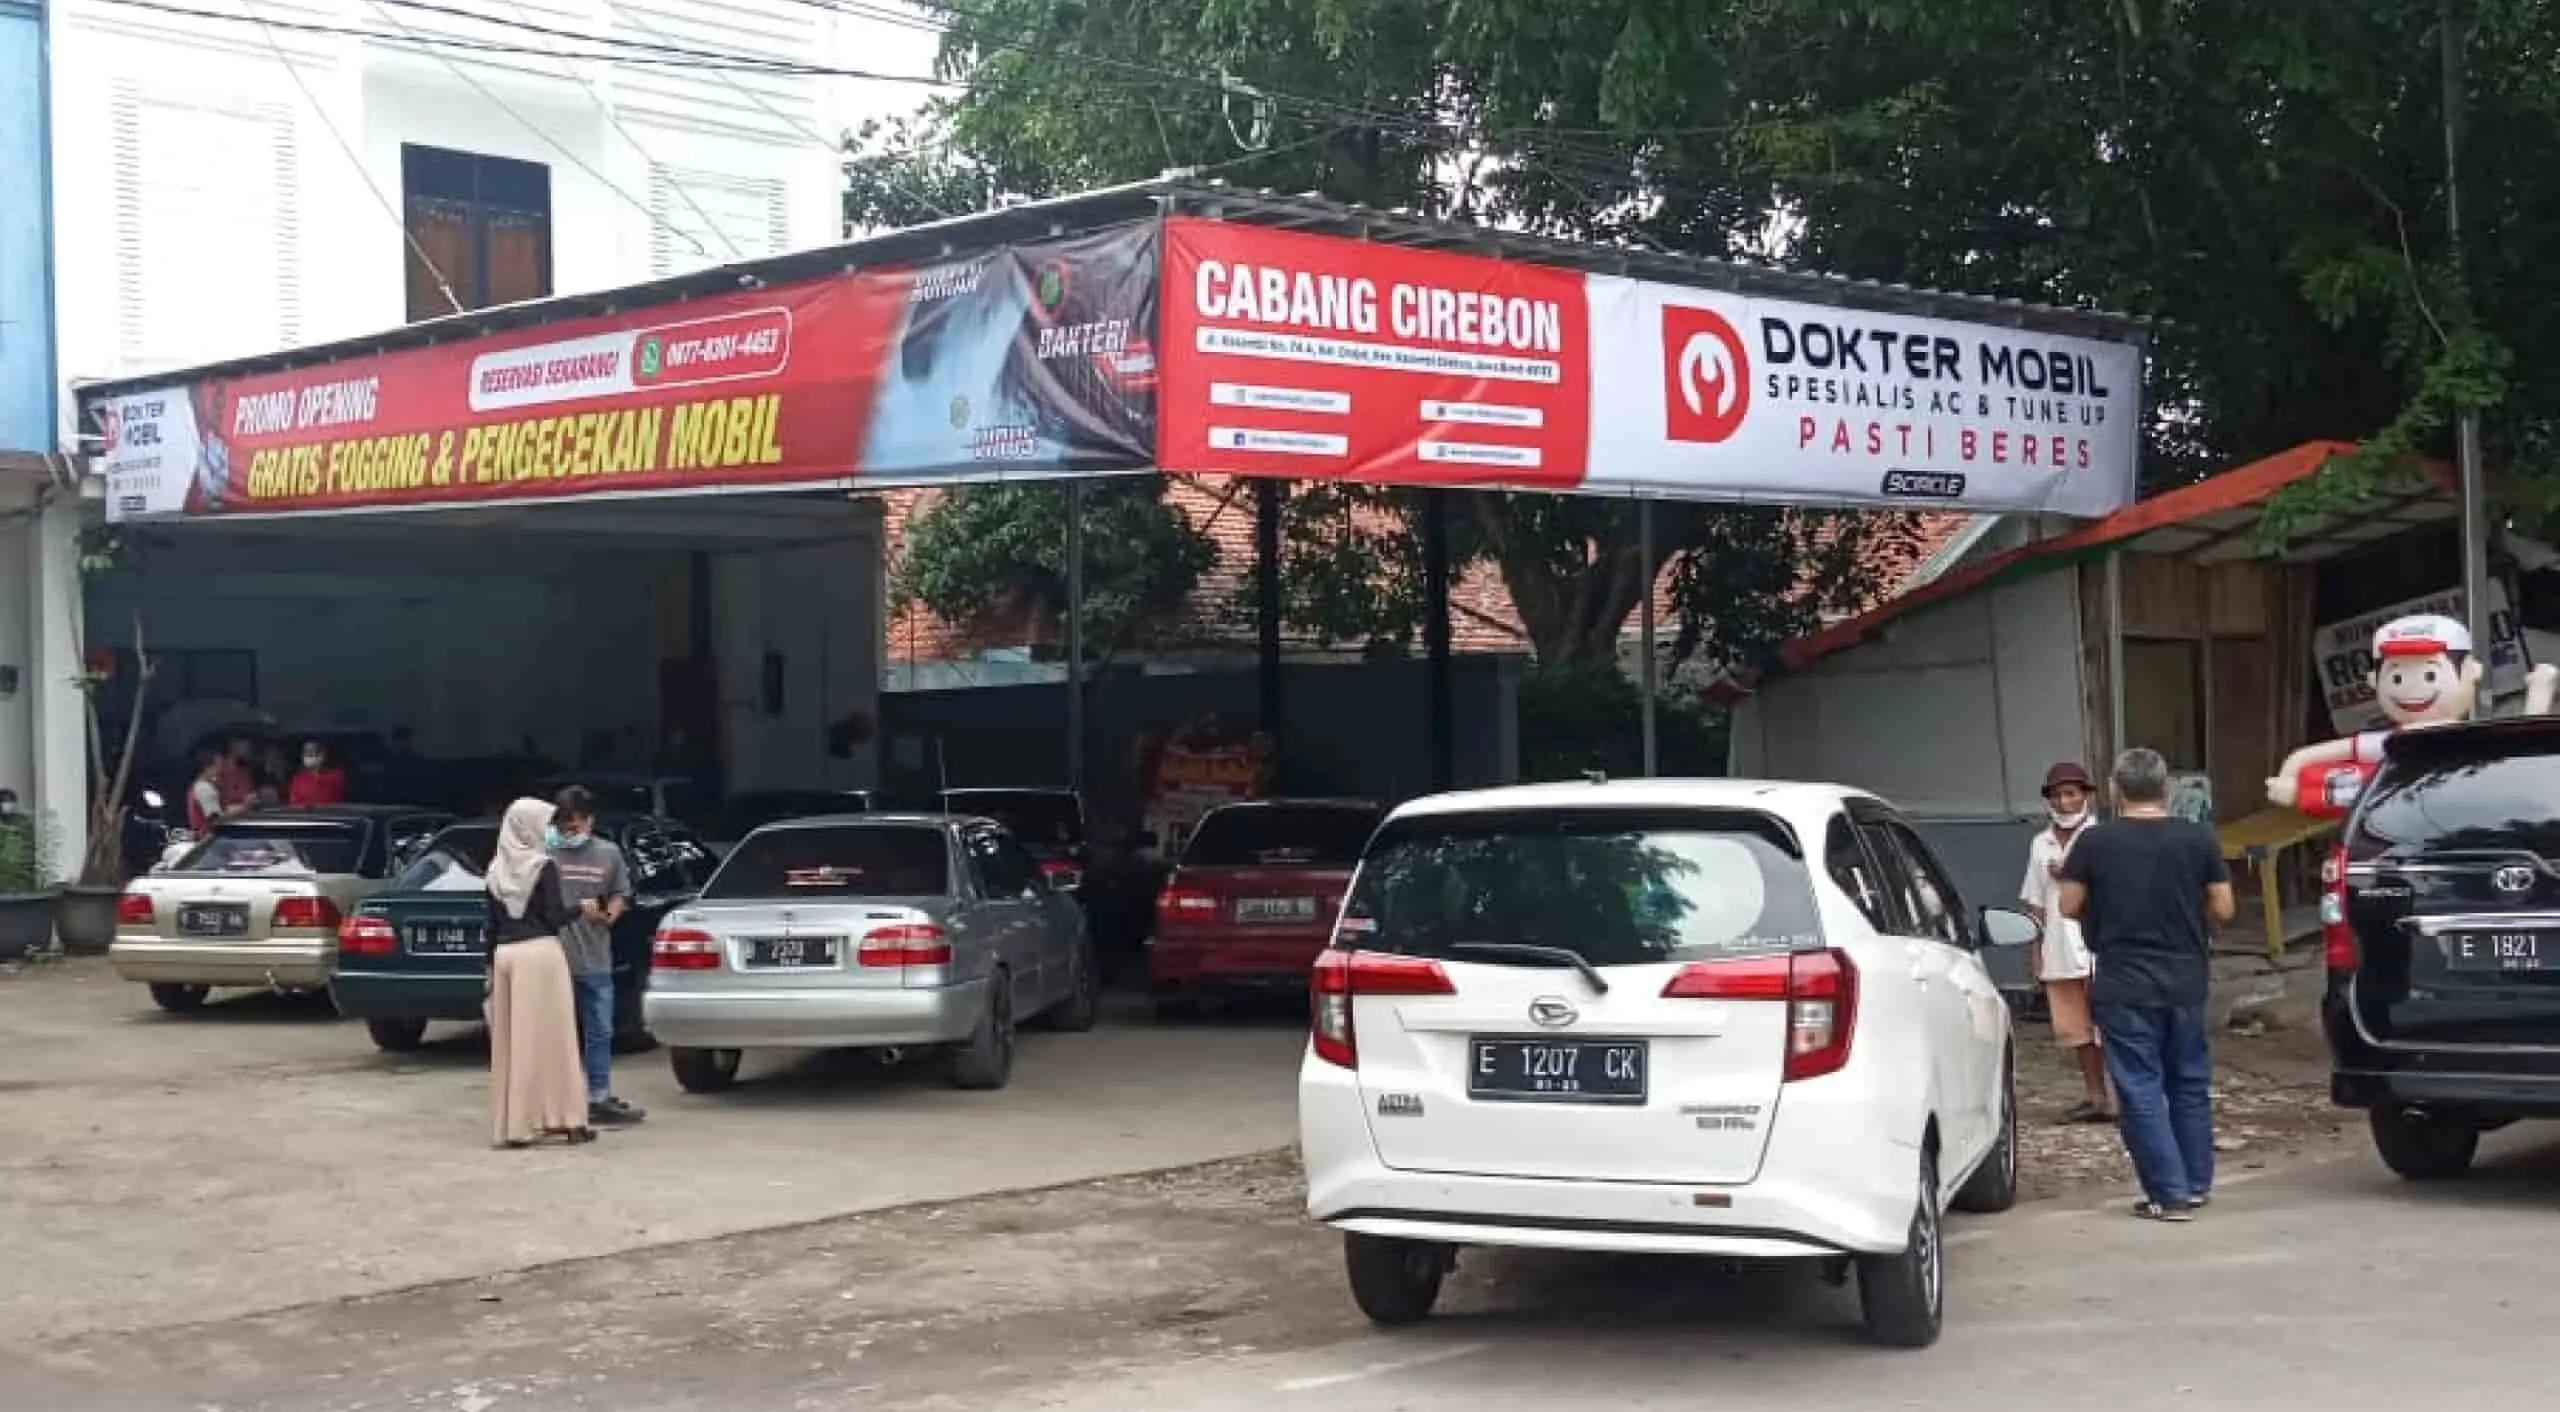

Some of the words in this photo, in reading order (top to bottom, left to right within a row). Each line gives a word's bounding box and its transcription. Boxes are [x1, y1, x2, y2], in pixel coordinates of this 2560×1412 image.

[1196, 260, 1378, 334] CABANG
[1391, 283, 1562, 352] CIREBON
[1760, 316, 1963, 382] DOKTER
[1980, 342, 2110, 397] MOBIL
[234, 388, 297, 436] PROMO
[299, 376, 380, 428] OPENING
[1767, 373, 1914, 411] SPESIALIS
[1930, 390, 1962, 416] AC
[2006, 396, 2069, 424] TUNE
[2079, 404, 2105, 426] UP
[247, 443, 322, 498] GRATIS
[326, 432, 430, 494] FOGGING
[431, 429, 456, 487] &
[459, 407, 665, 484] PENGECEKAN
[667, 394, 785, 470] MOBIL
[1799, 416, 1933, 460] PASTI
[1960, 429, 2091, 470] BERES
[2462, 935, 2474, 957] E
[2491, 935, 2536, 957] 1821
[1479, 1045, 1497, 1074] E
[1520, 1045, 1579, 1077] 1207
[1605, 1048, 1636, 1079] CK
